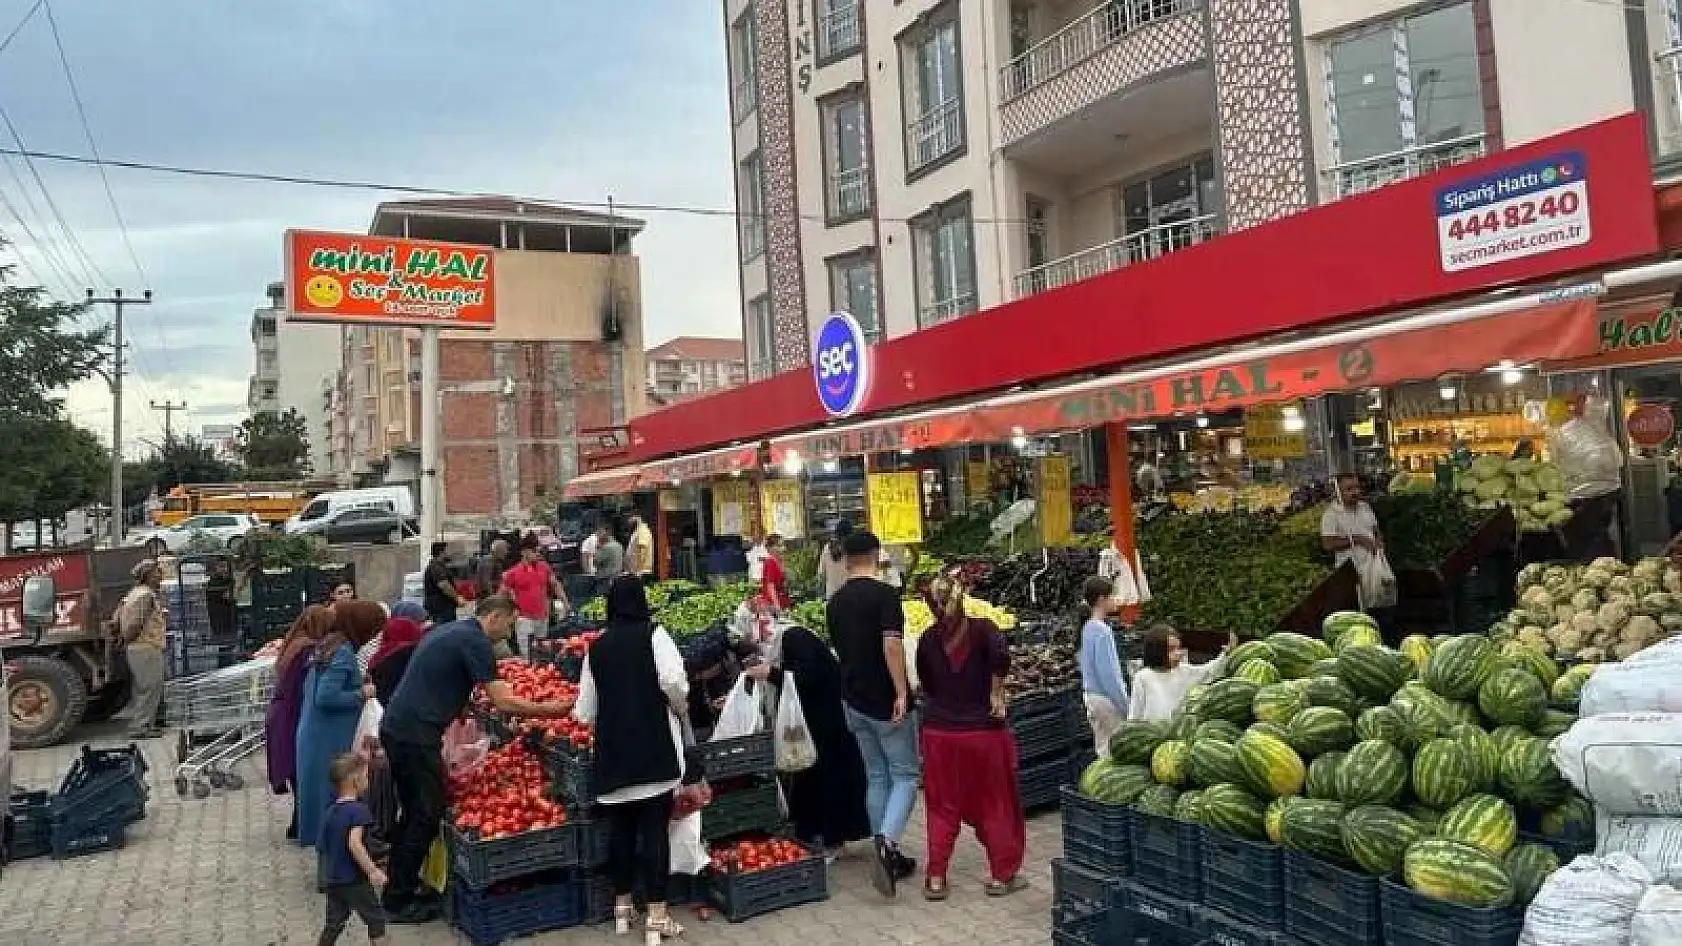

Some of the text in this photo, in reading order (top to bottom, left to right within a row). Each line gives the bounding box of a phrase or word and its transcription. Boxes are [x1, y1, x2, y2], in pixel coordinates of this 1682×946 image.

[1448, 209, 1500, 241] 444
[406, 247, 489, 282] HAL
[1171, 360, 1283, 406] HAL
